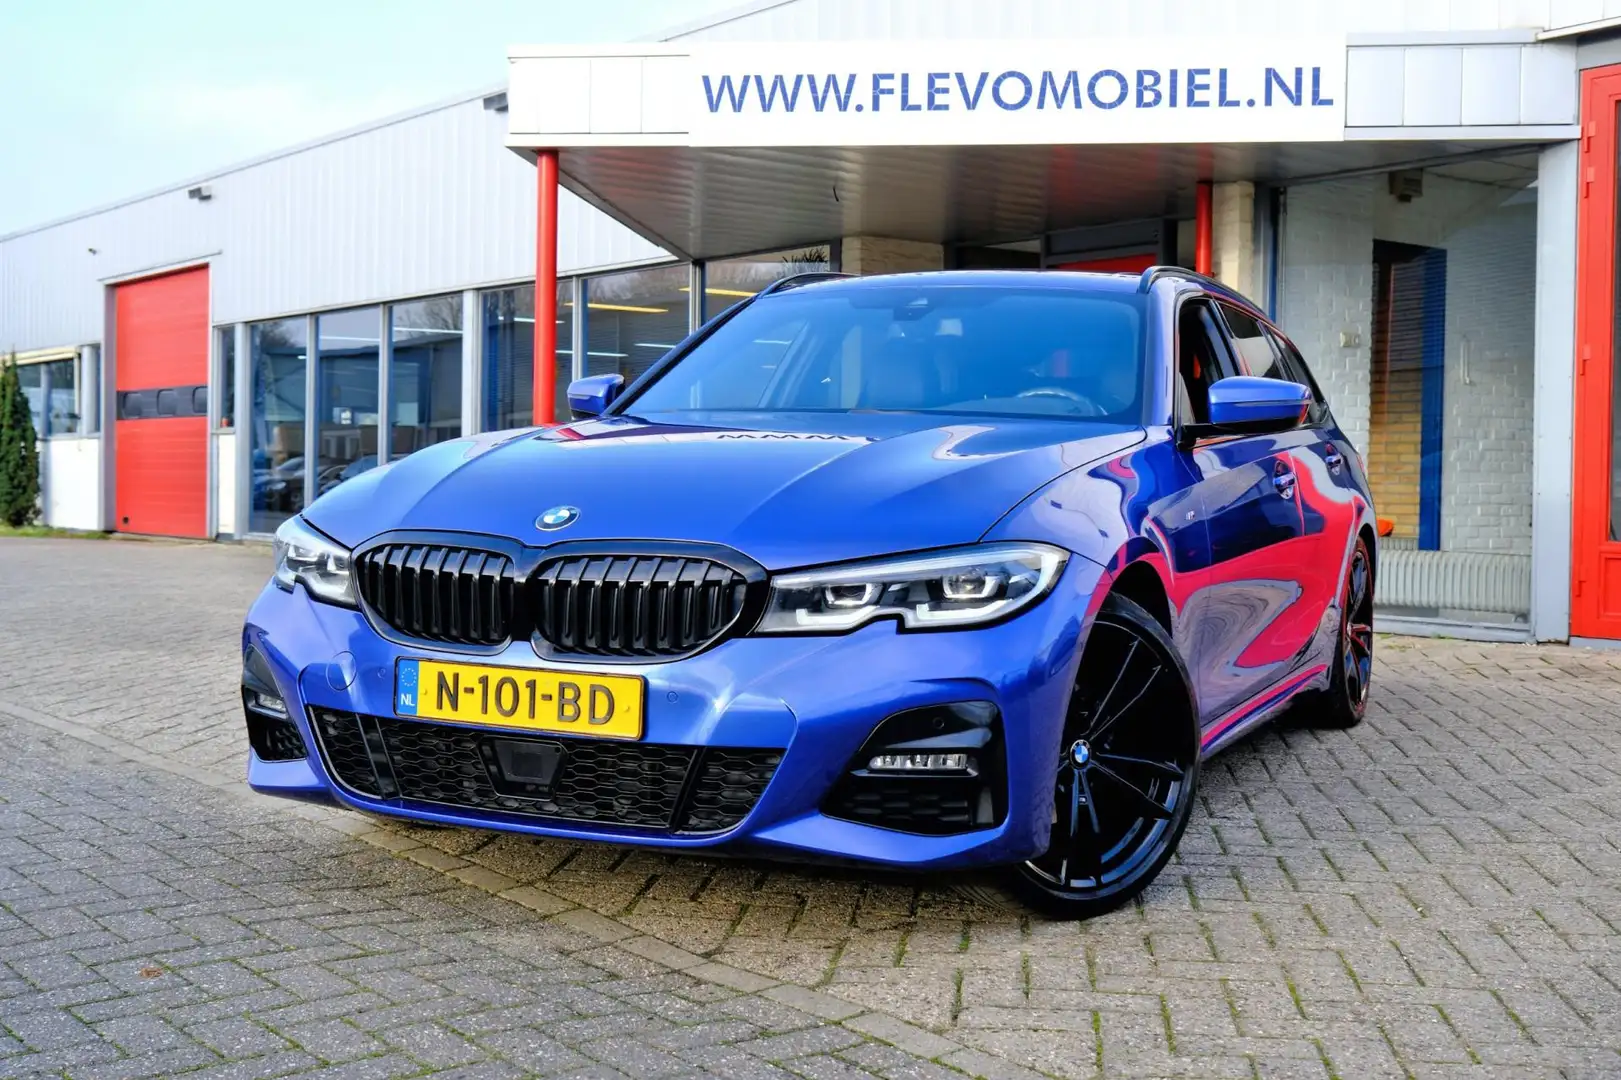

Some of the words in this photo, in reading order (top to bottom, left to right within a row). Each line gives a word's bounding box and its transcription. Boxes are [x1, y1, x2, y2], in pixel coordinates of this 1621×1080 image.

[701, 66, 1334, 113] WWW.FLEVOMOBIEL.NL
[400, 693, 415, 706] NL
[436, 671, 615, 725] N-101-BD
